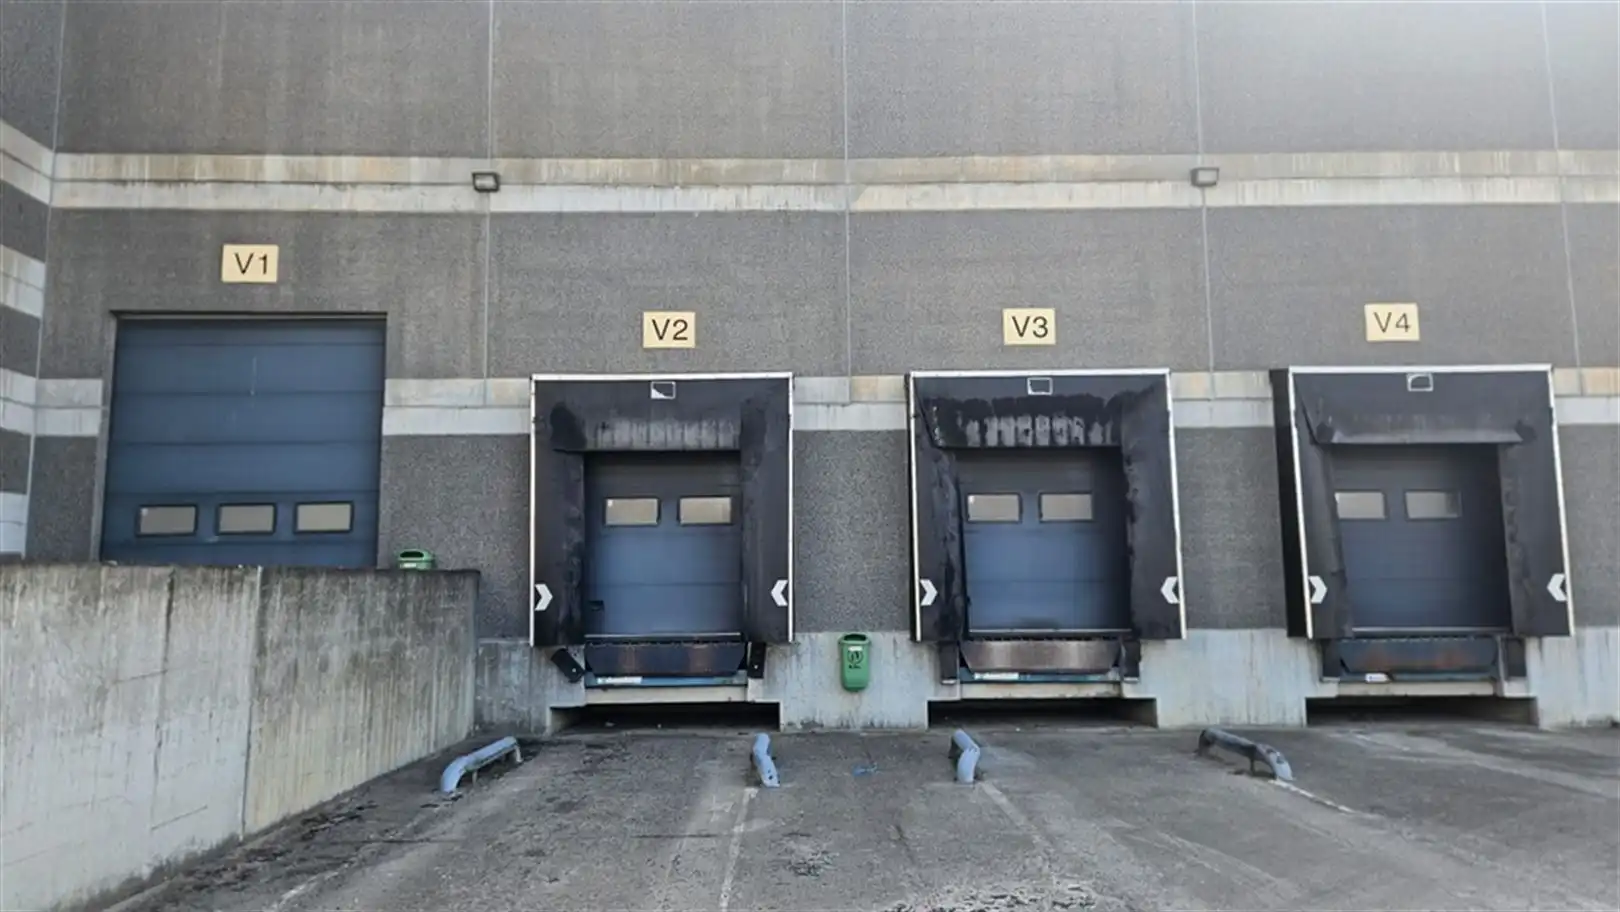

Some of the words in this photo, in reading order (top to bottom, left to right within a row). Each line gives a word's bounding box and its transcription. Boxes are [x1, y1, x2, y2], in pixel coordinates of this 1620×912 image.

[235, 253, 268, 275] V1
[651, 319, 688, 341] V2
[1011, 315, 1048, 338] V3
[1373, 311, 1411, 333] V4
